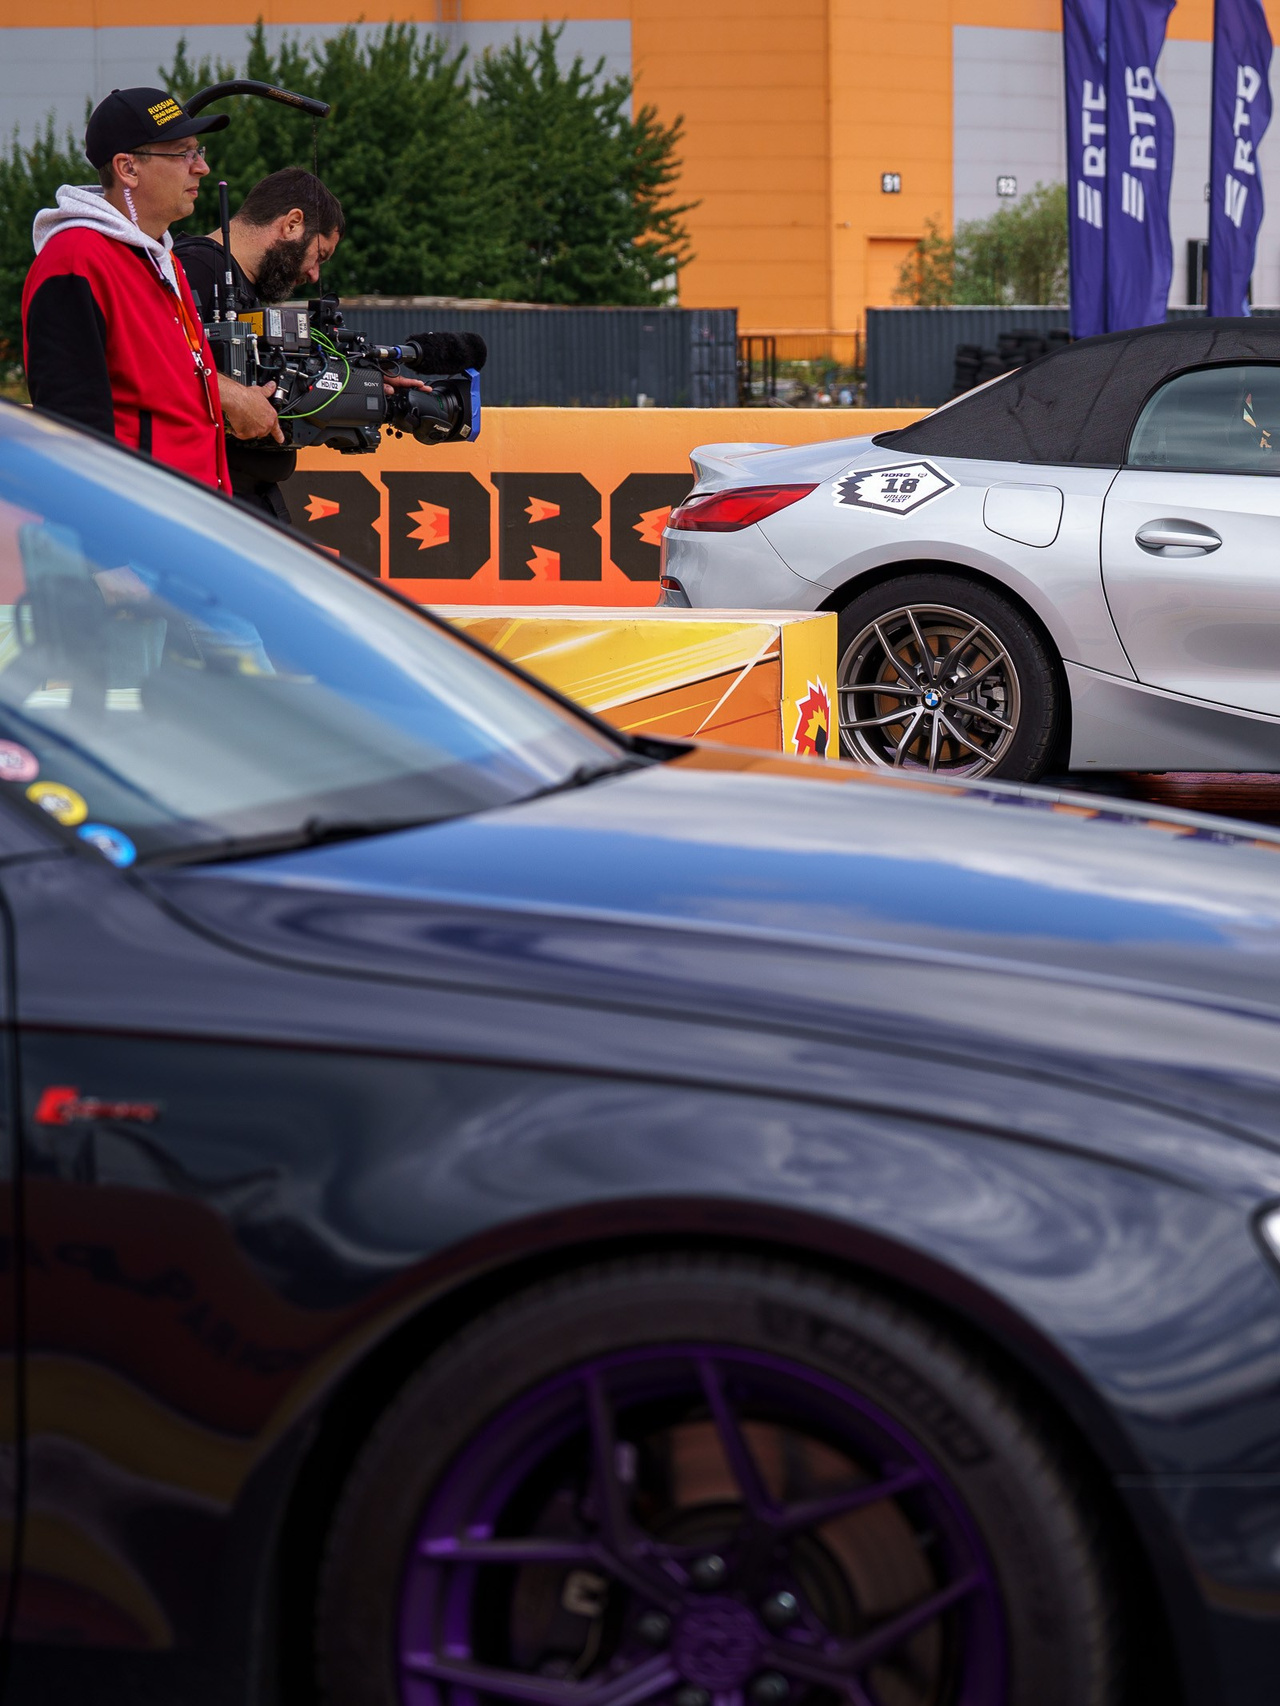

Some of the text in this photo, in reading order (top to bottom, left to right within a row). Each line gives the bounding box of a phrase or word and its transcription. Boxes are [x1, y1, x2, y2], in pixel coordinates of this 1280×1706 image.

[147, 98, 176, 116] RUSSIAN
[156, 110, 183, 127] COMMUNITY
[1124, 65, 1157, 170] ВТБ
[881, 478, 920, 493] 18
